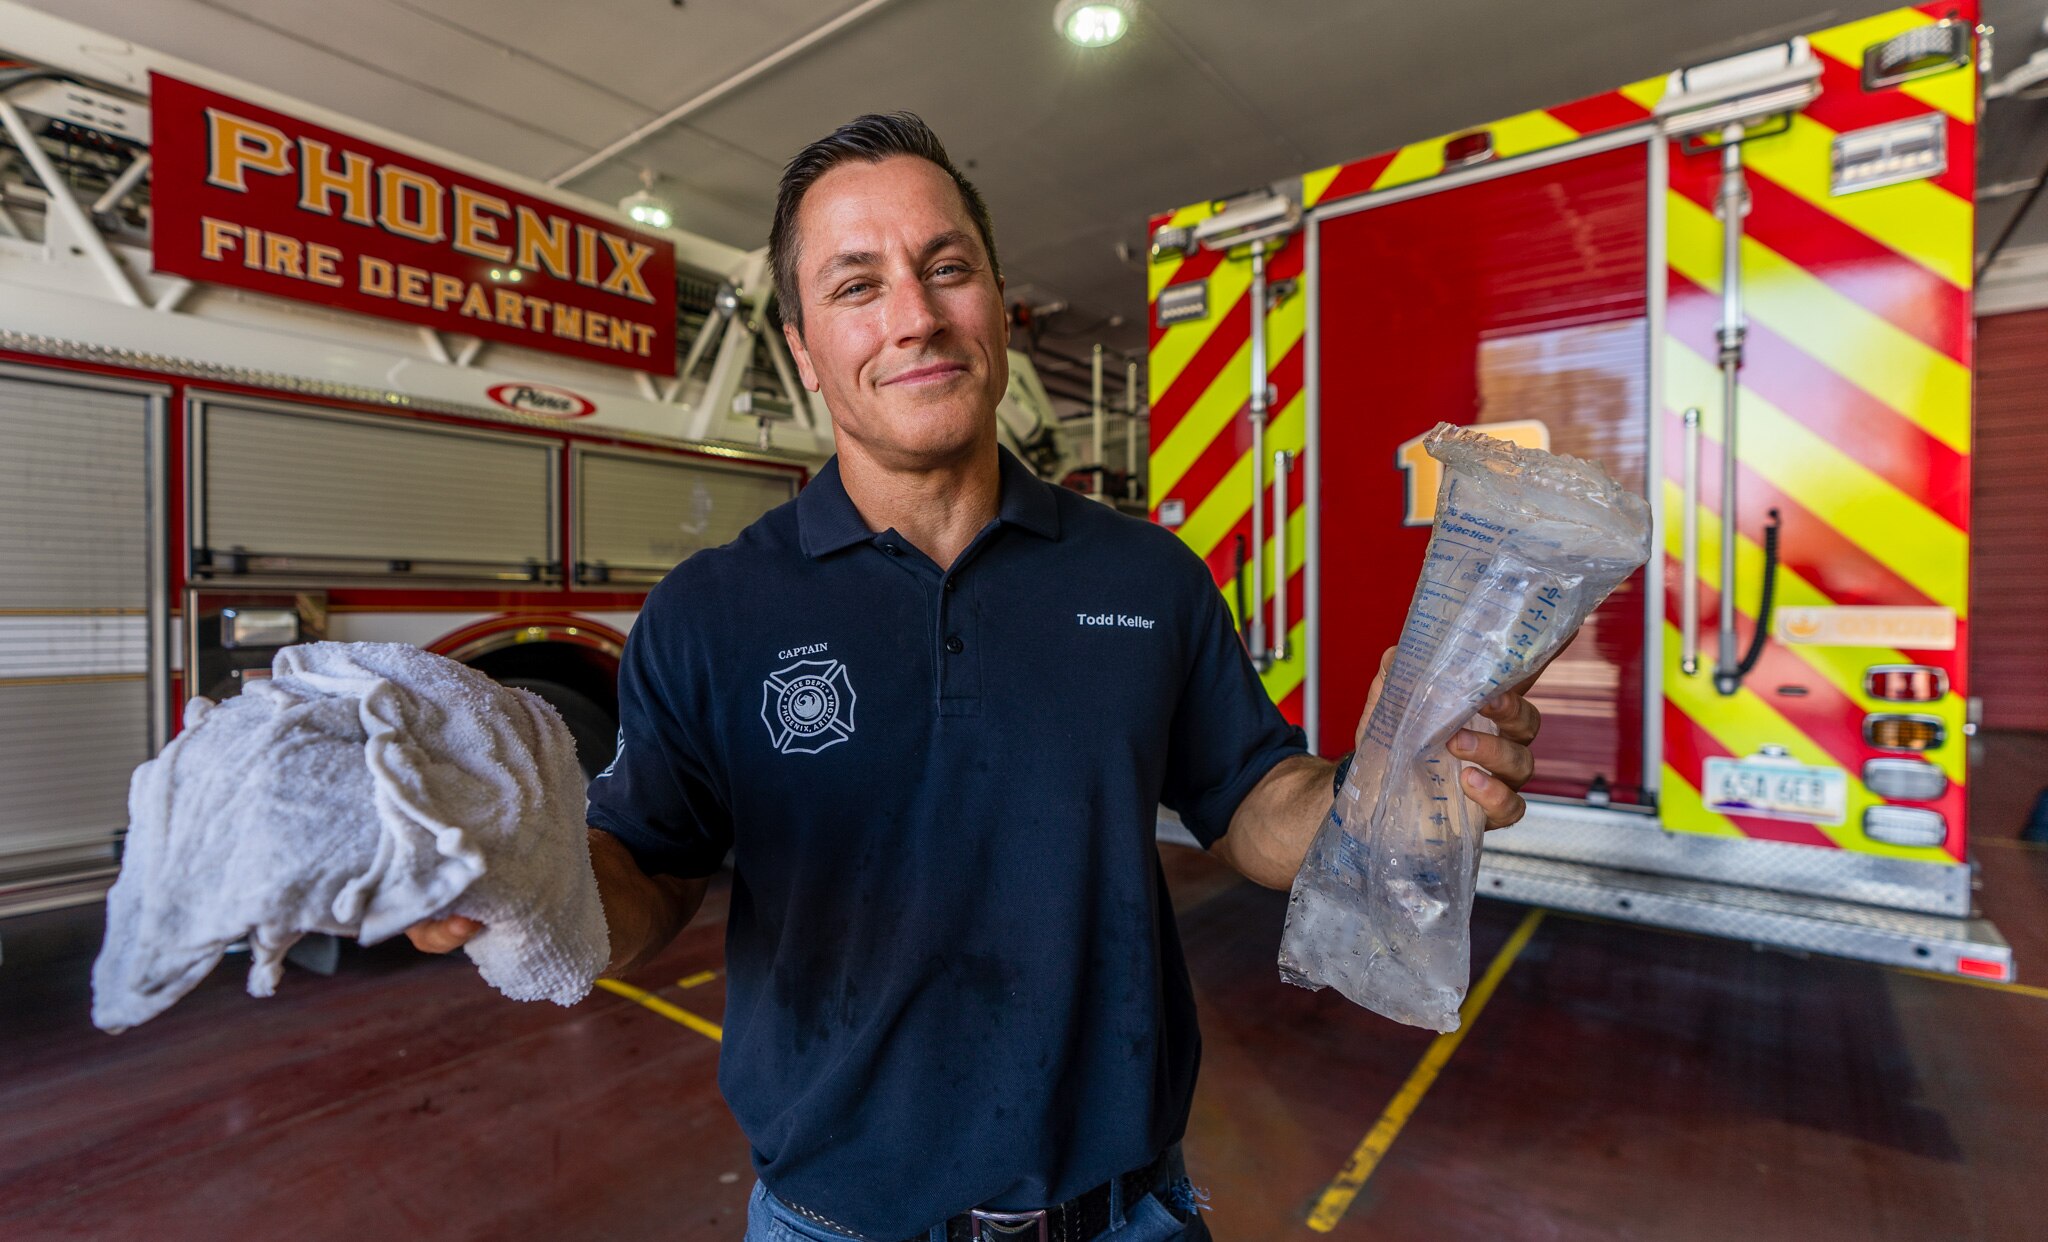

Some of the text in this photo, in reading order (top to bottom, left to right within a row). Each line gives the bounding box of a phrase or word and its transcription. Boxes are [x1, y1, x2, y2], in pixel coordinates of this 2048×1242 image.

[204, 106, 656, 305] PHOENIX
[201, 216, 657, 357] FIRE DEPARTMENT
[1076, 613, 1155, 629] Todd Keller
[778, 642, 828, 660] CAPTAIN
[787, 679, 825, 696] FIRE DEPT.
[781, 694, 835, 732] PHOENIX, ARIZONA
